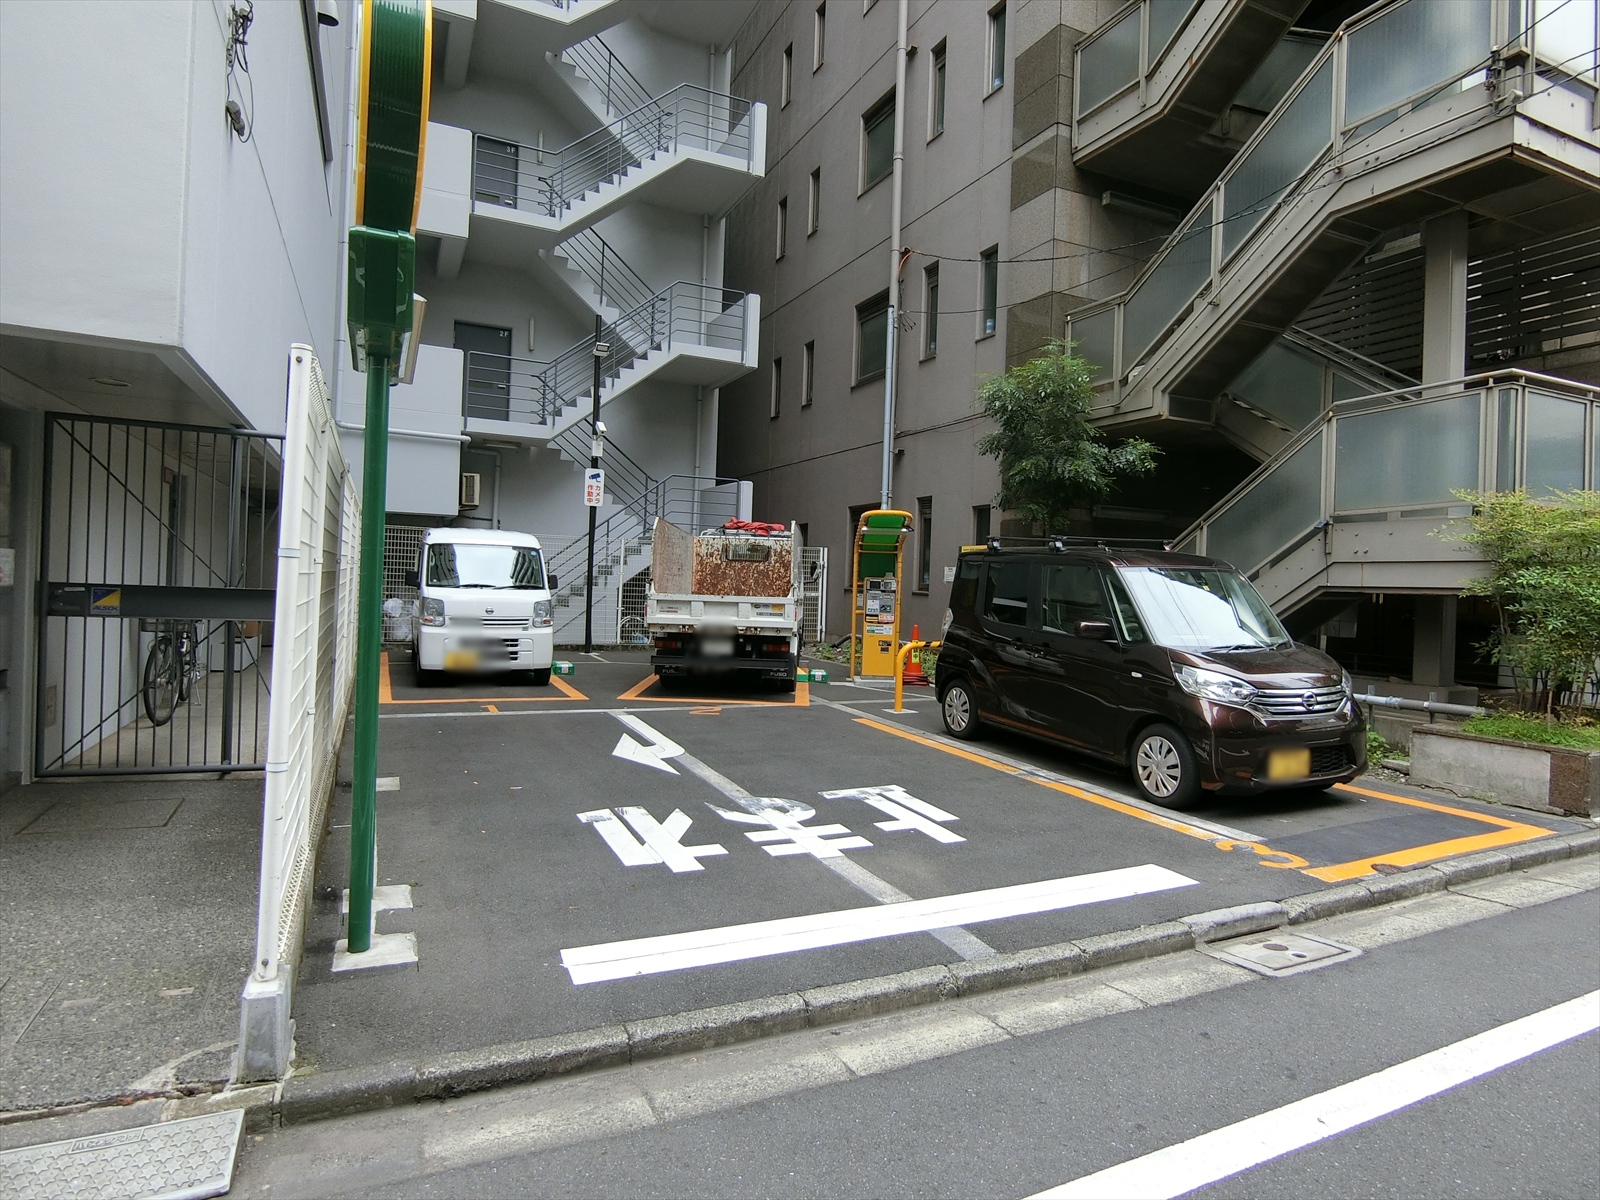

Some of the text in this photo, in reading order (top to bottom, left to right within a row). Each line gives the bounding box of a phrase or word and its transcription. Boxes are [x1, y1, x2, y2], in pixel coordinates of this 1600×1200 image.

[689, 706, 722, 715] 2
[576, 784, 967, 873] 止まれ
[1215, 839, 1310, 869] 3
